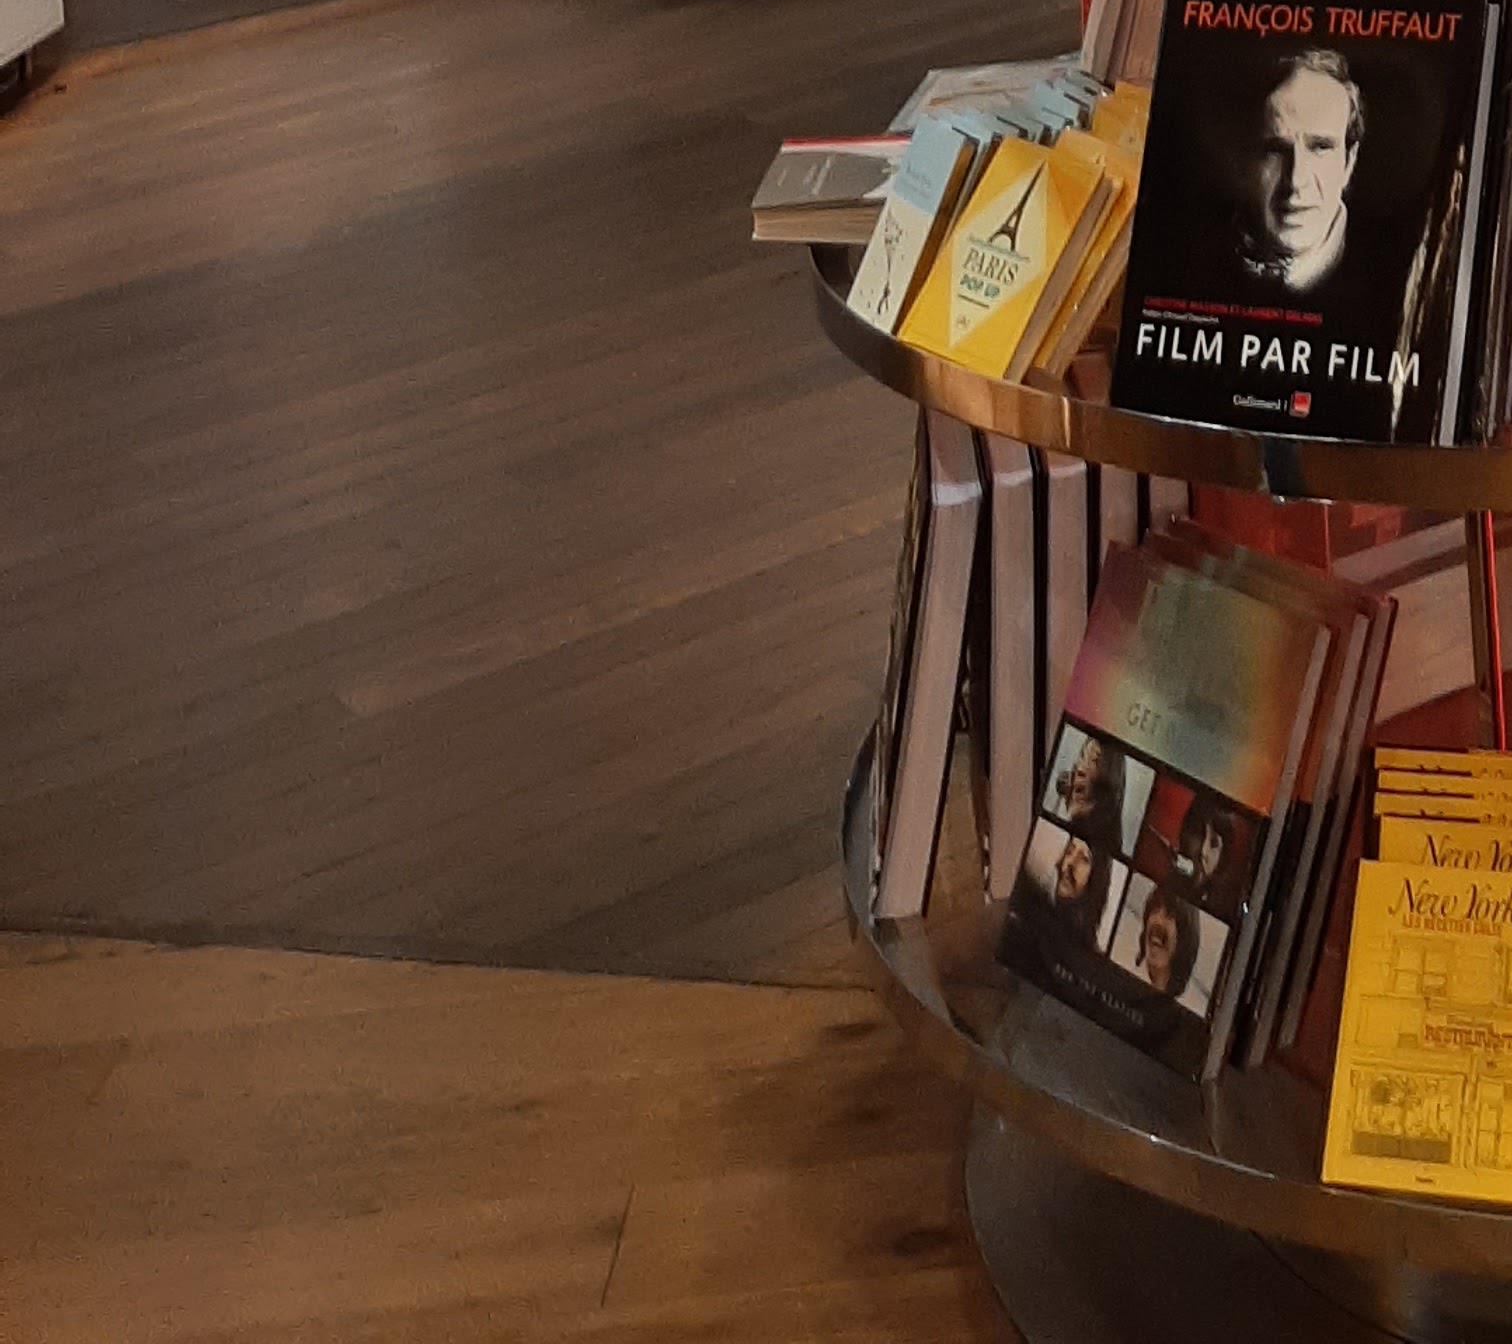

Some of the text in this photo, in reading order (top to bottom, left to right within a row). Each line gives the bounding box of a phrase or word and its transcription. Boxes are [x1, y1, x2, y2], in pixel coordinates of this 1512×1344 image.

[1183, 0, 1463, 42] FRANÇOIS TRUFFAUT
[963, 247, 1019, 285] PARIS
[1136, 322, 1421, 388] FILM PAR FILM
[1127, 703, 1162, 735] GET
[1421, 834, 1482, 870] New
[1388, 878, 1459, 919] New
